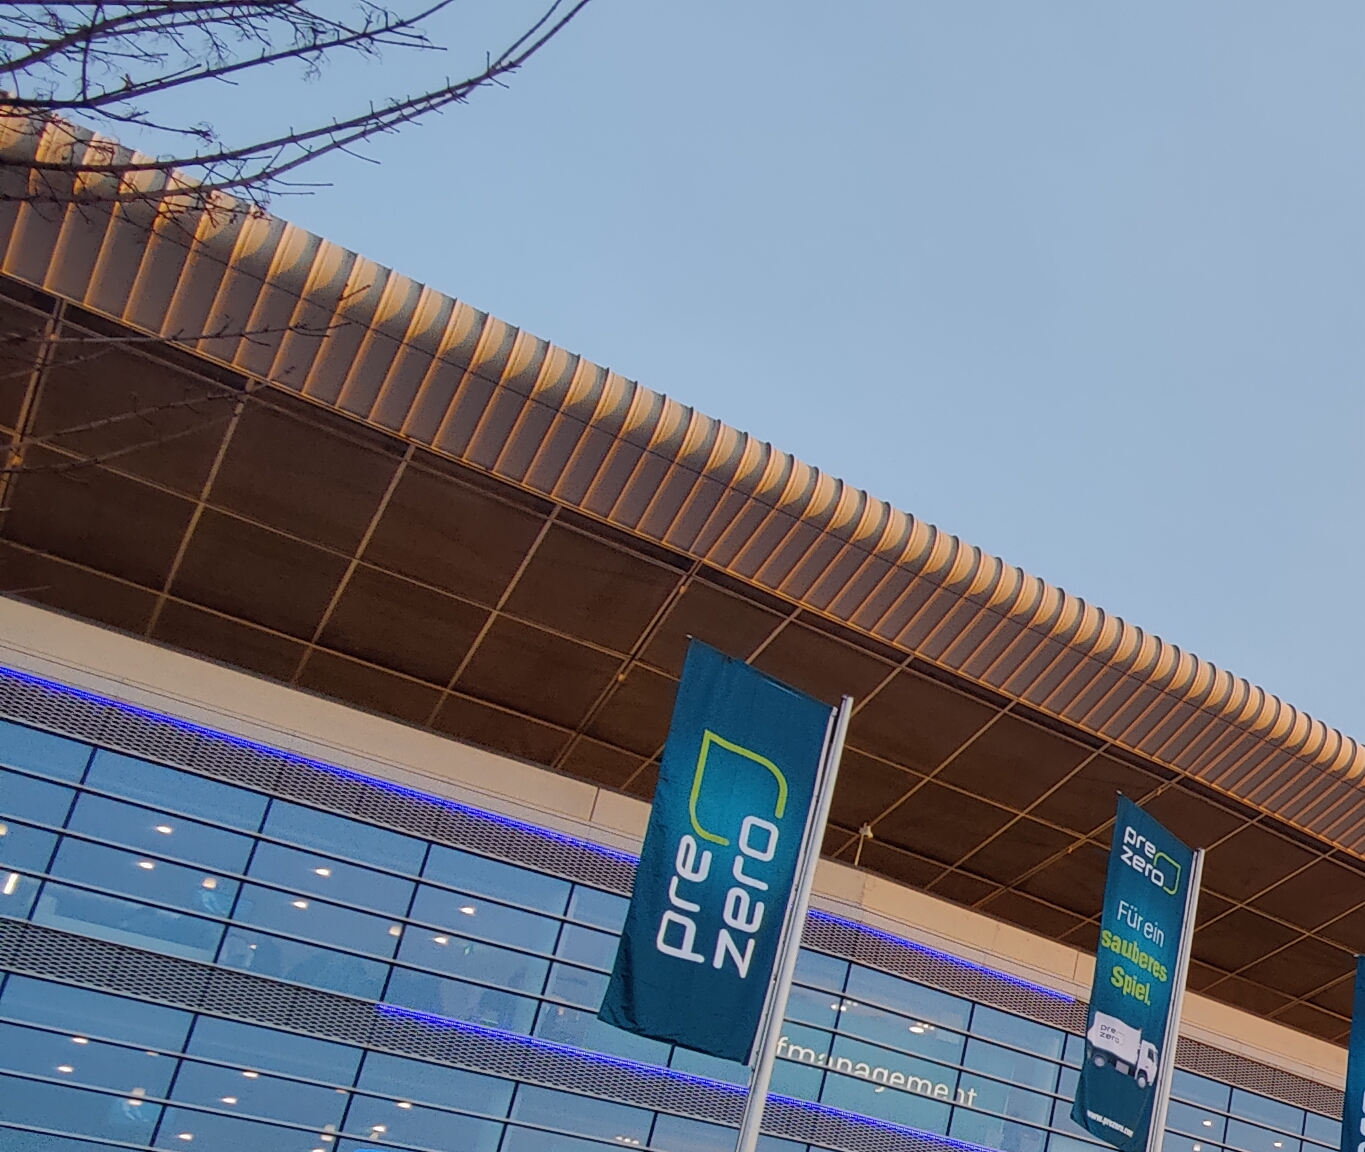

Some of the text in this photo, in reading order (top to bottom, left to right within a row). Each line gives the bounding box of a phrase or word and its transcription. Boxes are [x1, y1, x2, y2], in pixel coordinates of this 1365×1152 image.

[1124, 825, 1157, 858] pre
[1120, 844, 1165, 888] zero
[656, 834, 713, 964] pre
[713, 815, 780, 979] zero
[1117, 900, 1165, 948] Für ein
[1101, 928, 1168, 983] sauberes
[1110, 965, 1151, 1006] Spiel.
[1100, 1024, 1117, 1034] pre
[1100, 1032, 1120, 1044] zero
[777, 1036, 978, 1106] fmanagement
